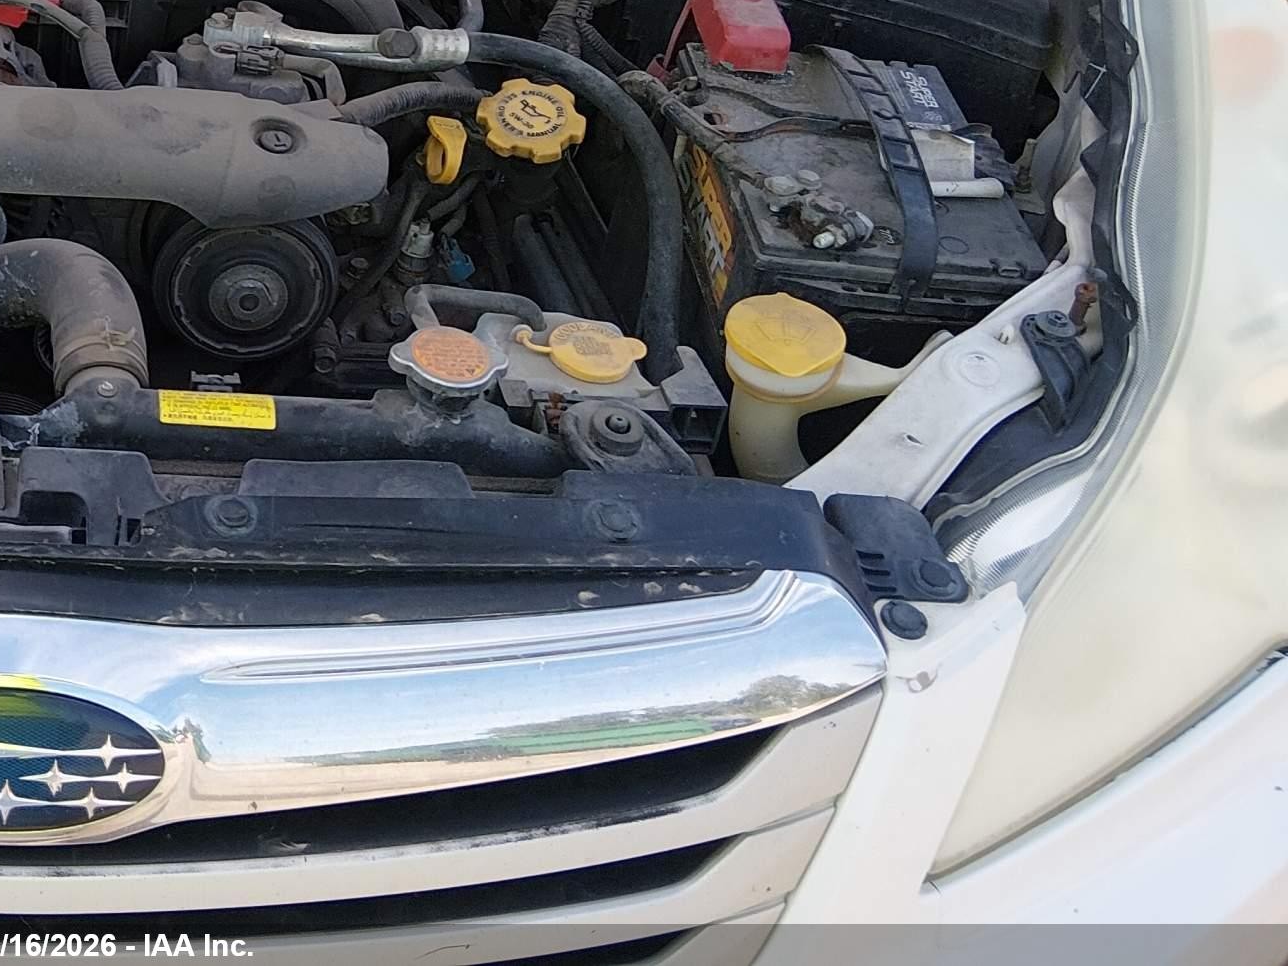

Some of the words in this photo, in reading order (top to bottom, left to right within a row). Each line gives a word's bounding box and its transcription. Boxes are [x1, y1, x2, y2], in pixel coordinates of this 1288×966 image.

[521, 90, 559, 105] ENGINE
[555, 106, 564, 118] OIL
[899, 70, 928, 108] START
[917, 76, 940, 108] SUPER
[526, 122, 562, 137] MANUAL
